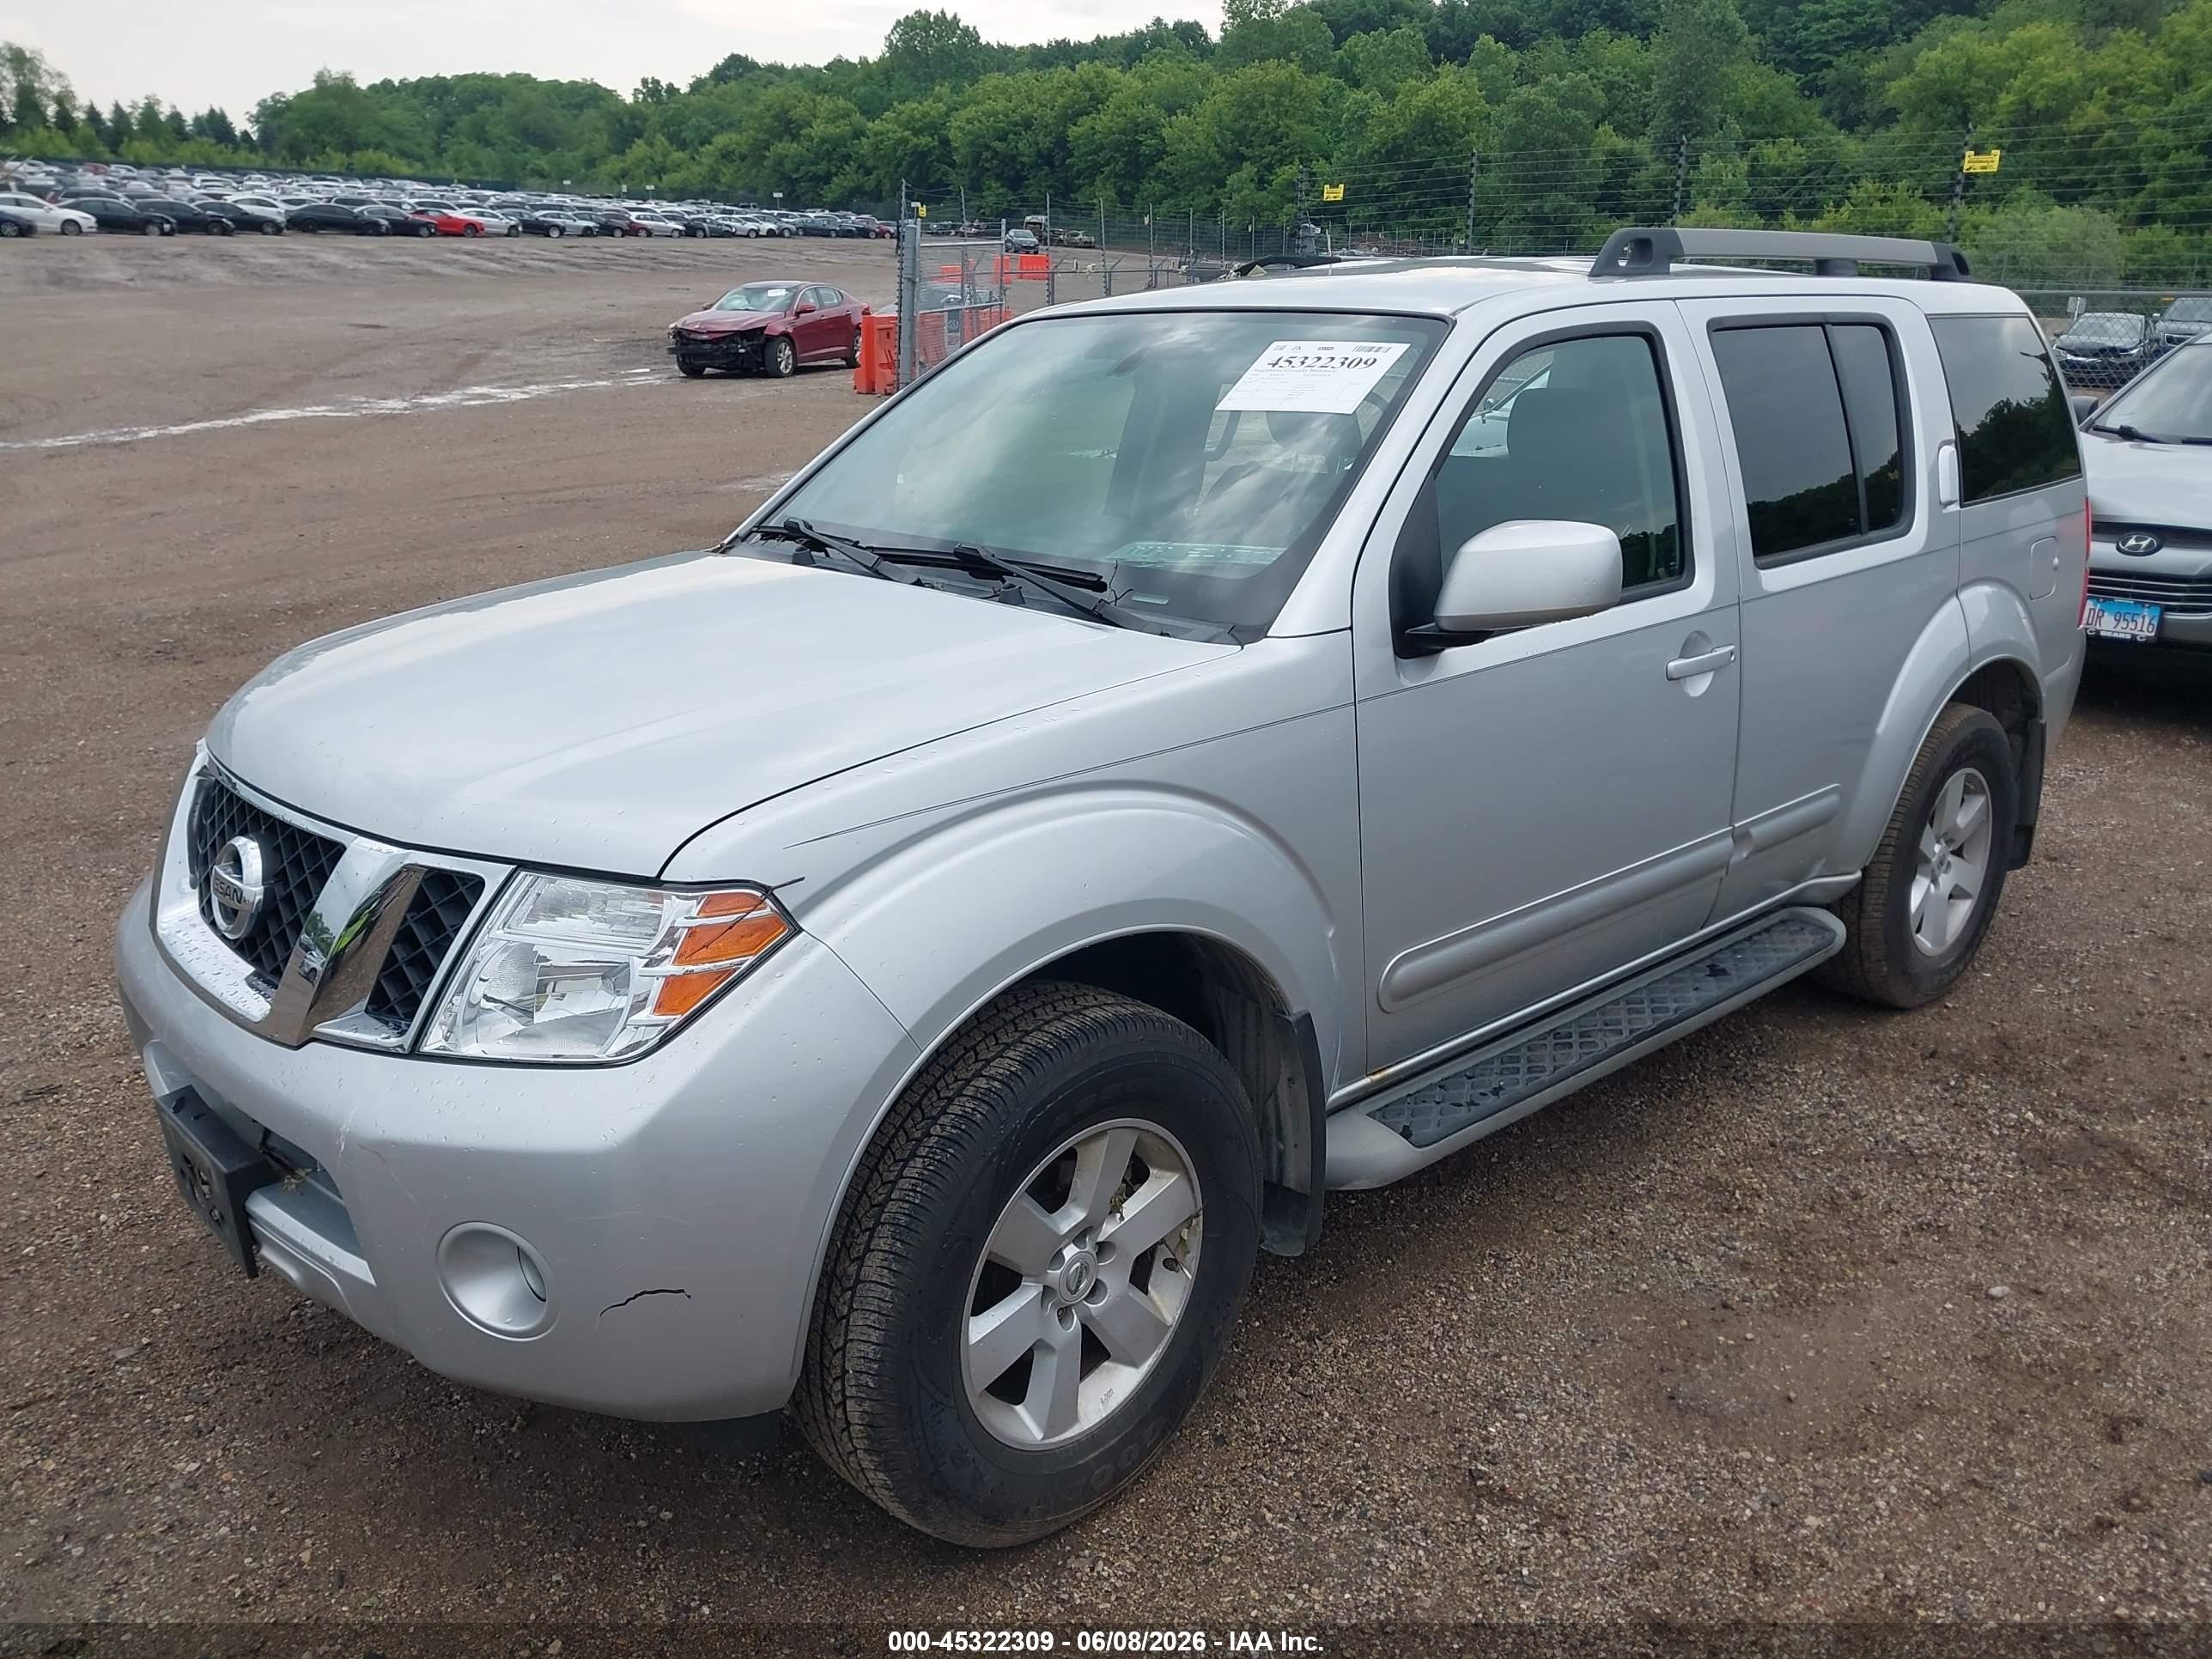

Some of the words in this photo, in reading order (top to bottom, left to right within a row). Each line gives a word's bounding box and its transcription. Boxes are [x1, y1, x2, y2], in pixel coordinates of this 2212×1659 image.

[1267, 356, 1377, 369] 45322309
[2087, 608, 2105, 627] DR
[2113, 611, 2155, 633] 95516
